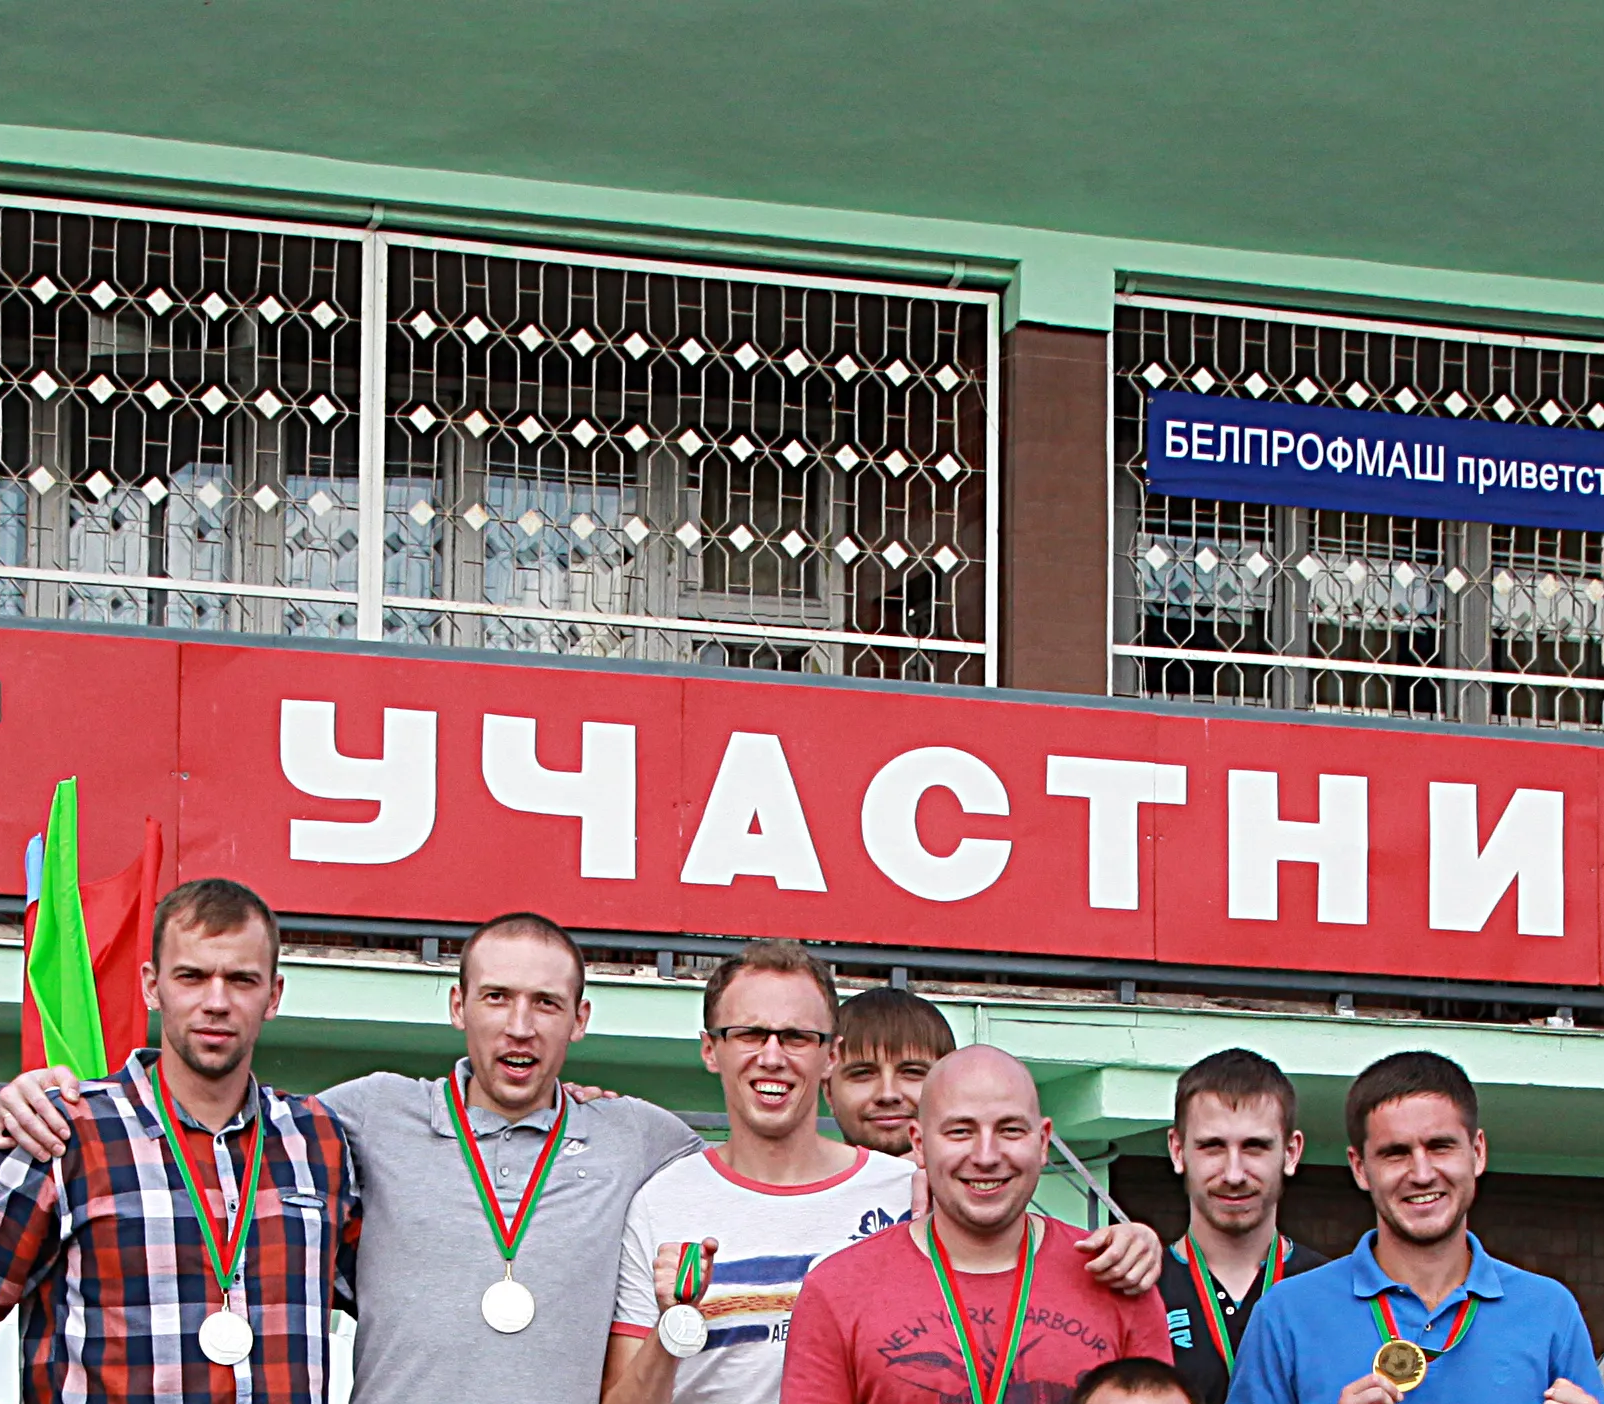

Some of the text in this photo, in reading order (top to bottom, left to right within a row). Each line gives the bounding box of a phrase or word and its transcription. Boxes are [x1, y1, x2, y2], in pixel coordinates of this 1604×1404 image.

[1165, 420, 1445, 482] БЕЛПРОФМАШ
[877, 1317, 929, 1367] NEW
[932, 1307, 996, 1330] YRK
[1024, 1307, 1109, 1358] ARBOUR
